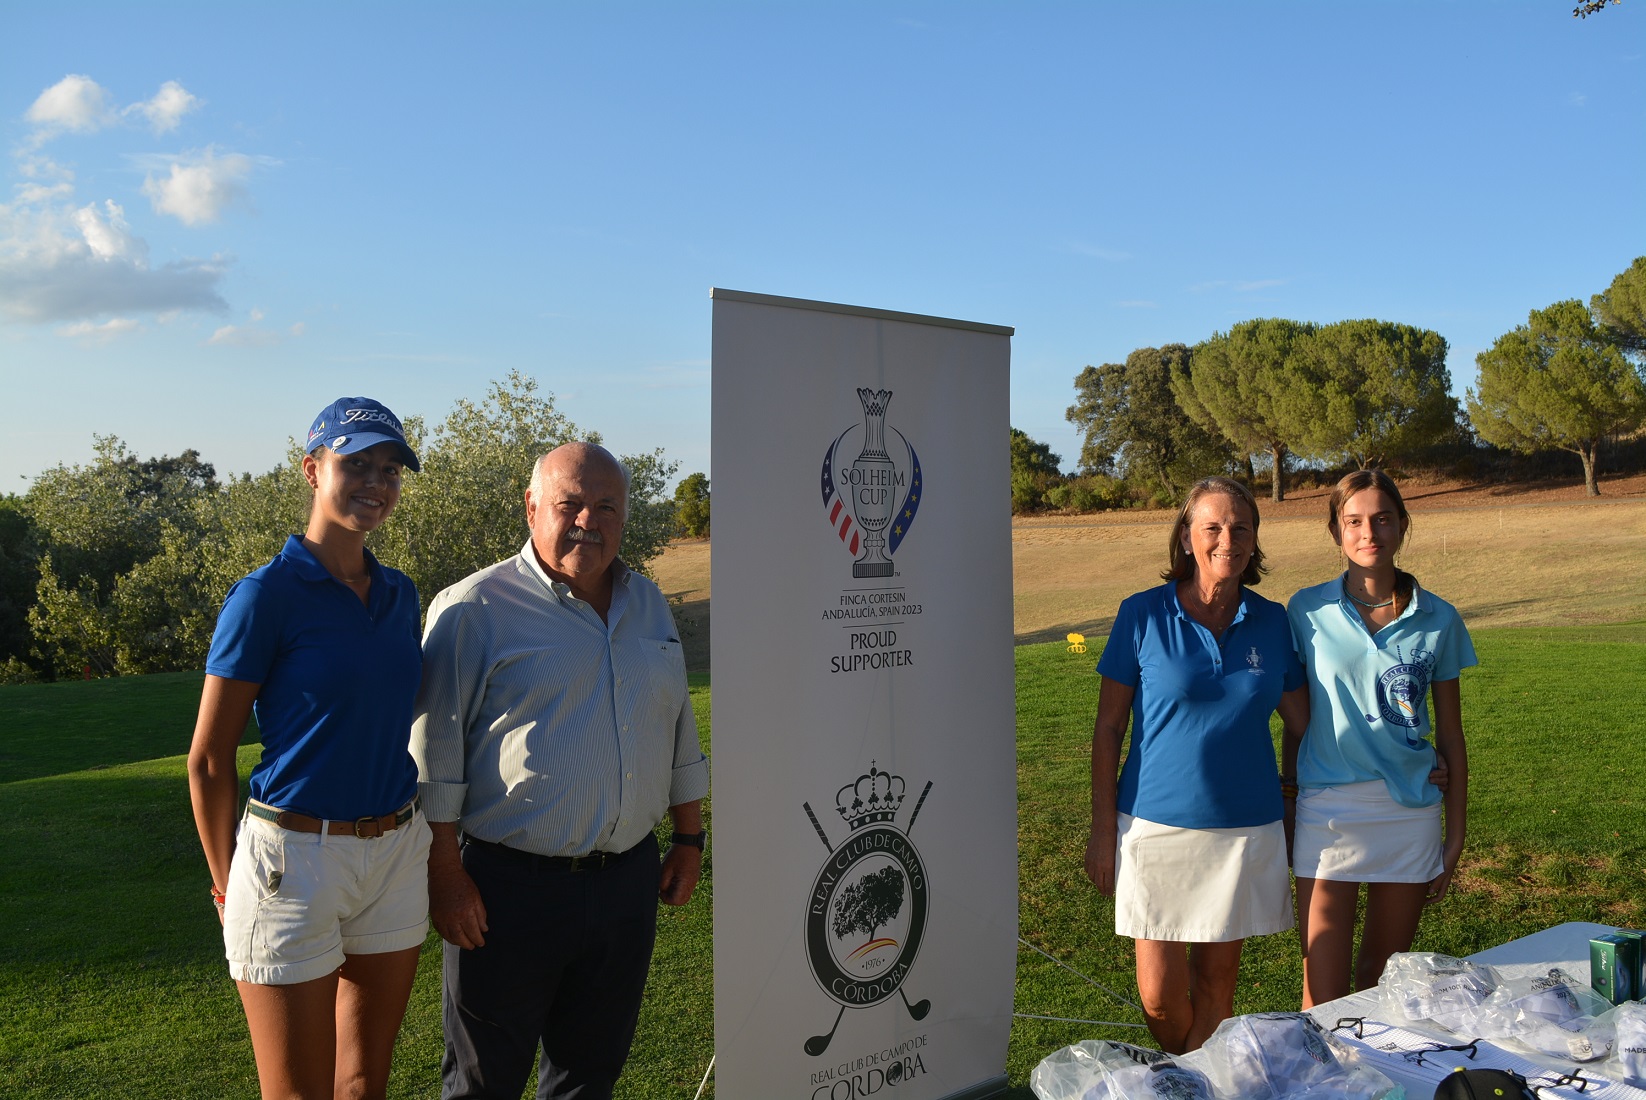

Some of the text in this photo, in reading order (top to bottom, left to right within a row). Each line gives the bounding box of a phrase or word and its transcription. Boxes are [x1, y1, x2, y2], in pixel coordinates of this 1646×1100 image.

[841, 468, 905, 487] SOLHEIM
[860, 488, 887, 505] CUP
[840, 592, 906, 606] FINCA CORTESIN
[822, 604, 923, 620] ANDALUCÍA, SPAIN 2023
[850, 630, 897, 650] PROUD
[831, 649, 913, 673] SUPPORTER
[812, 833, 922, 915] REAL CLUB DE CAMPO
[832, 962, 908, 1002] CÓRDOBA
[810, 1034, 928, 1085] REAL CLUB DE CAMPO DE
